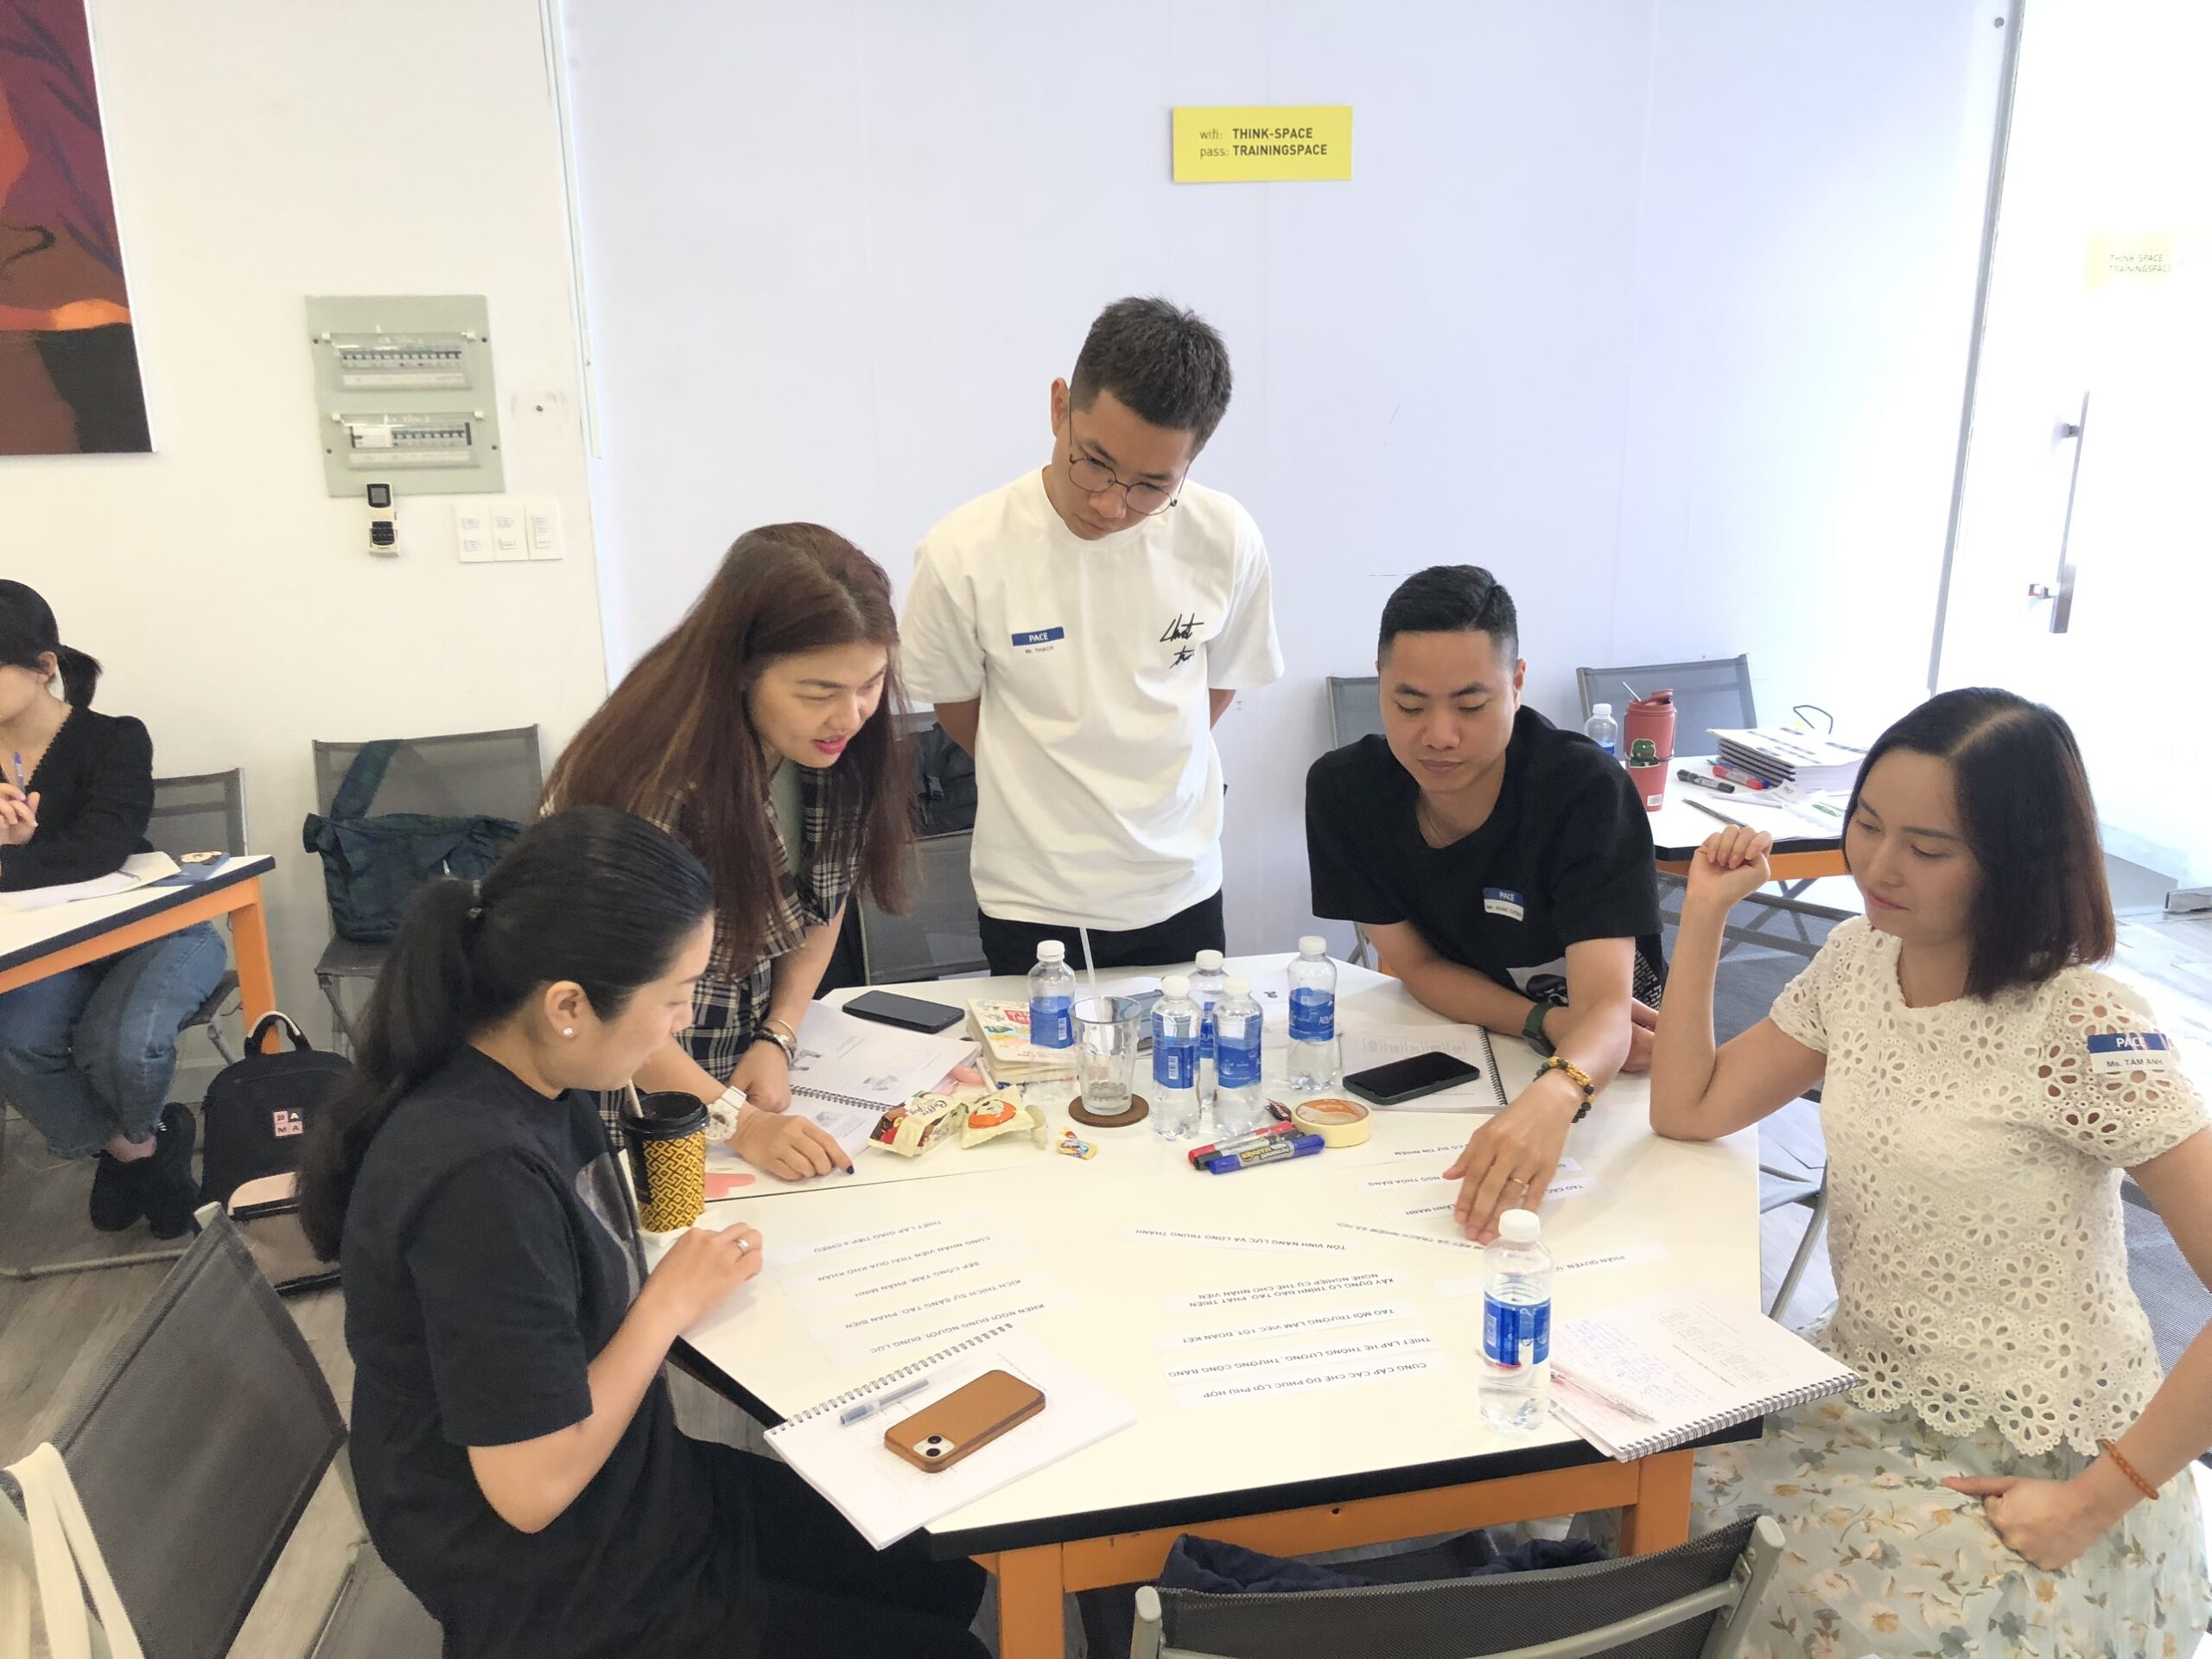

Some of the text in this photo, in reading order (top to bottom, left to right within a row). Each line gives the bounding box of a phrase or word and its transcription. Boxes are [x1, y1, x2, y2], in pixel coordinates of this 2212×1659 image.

[1199, 127, 1313, 140] wifi: THINK-SPACE
[1199, 144, 1328, 159] pass: TRAININGSPACE
[1028, 632, 1049, 643] PACE
[1499, 891, 1515, 902] PACE
[869, 1260, 889, 1268] QUA
[1018, 1304, 1044, 1313] KHEN
[1396, 1363, 1427, 1371] CUNG
